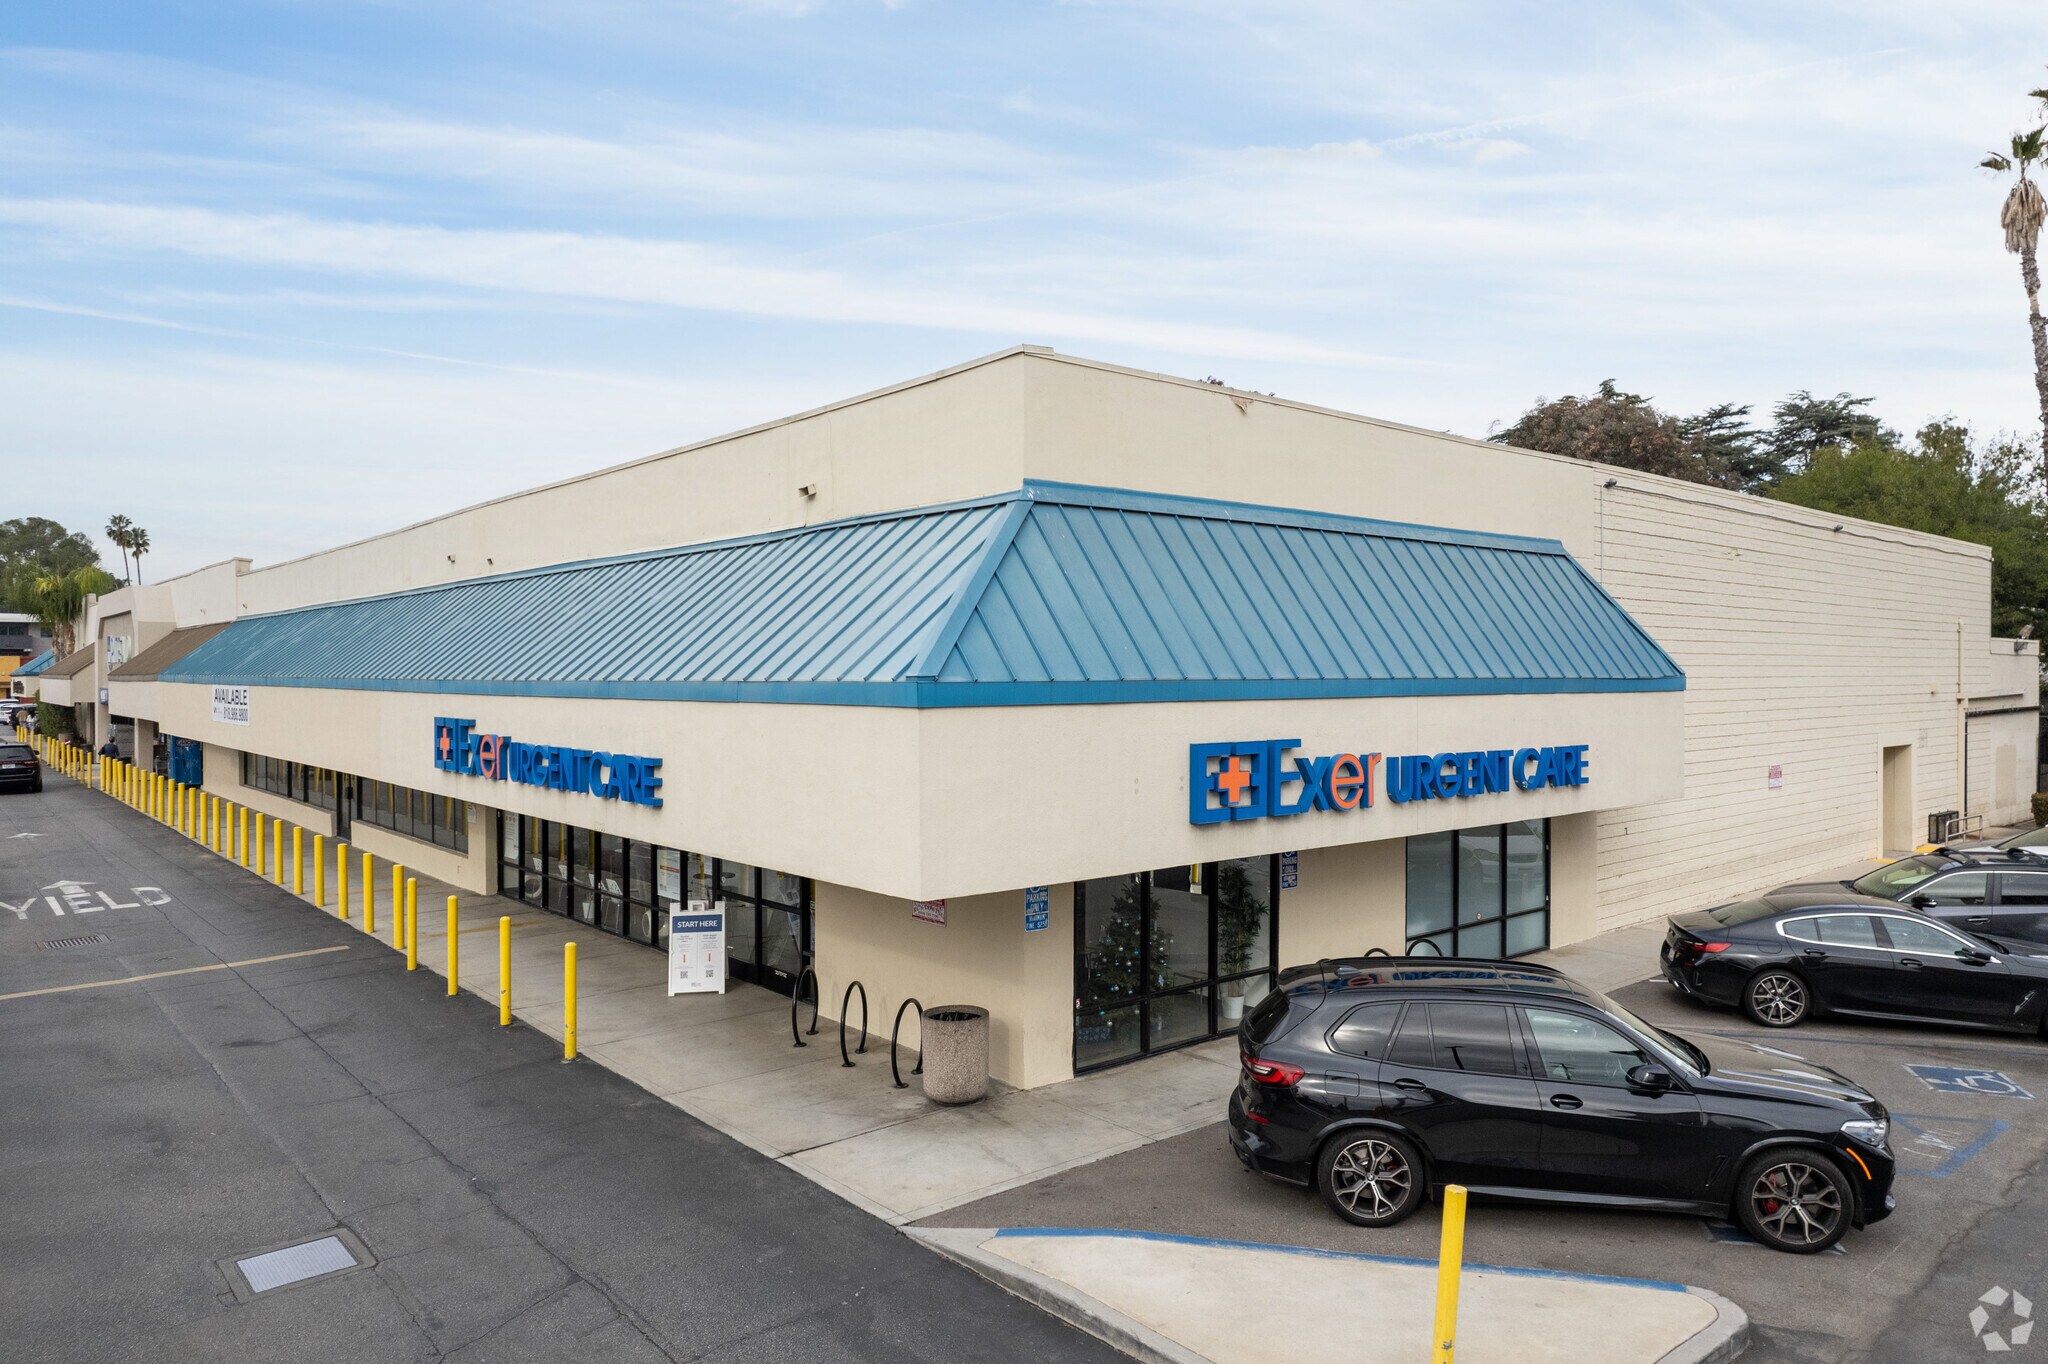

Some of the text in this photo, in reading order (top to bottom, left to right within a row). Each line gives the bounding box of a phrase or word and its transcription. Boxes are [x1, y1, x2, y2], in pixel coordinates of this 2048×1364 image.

[214, 688, 247, 705] AVAILABLE
[455, 718, 664, 808] Exer URGENT CARE
[1267, 738, 1590, 812] Exer URGENT CARE
[0, 886, 172, 920] YIELD
[1030, 902, 1044, 913] ONLY
[677, 921, 699, 929] START
